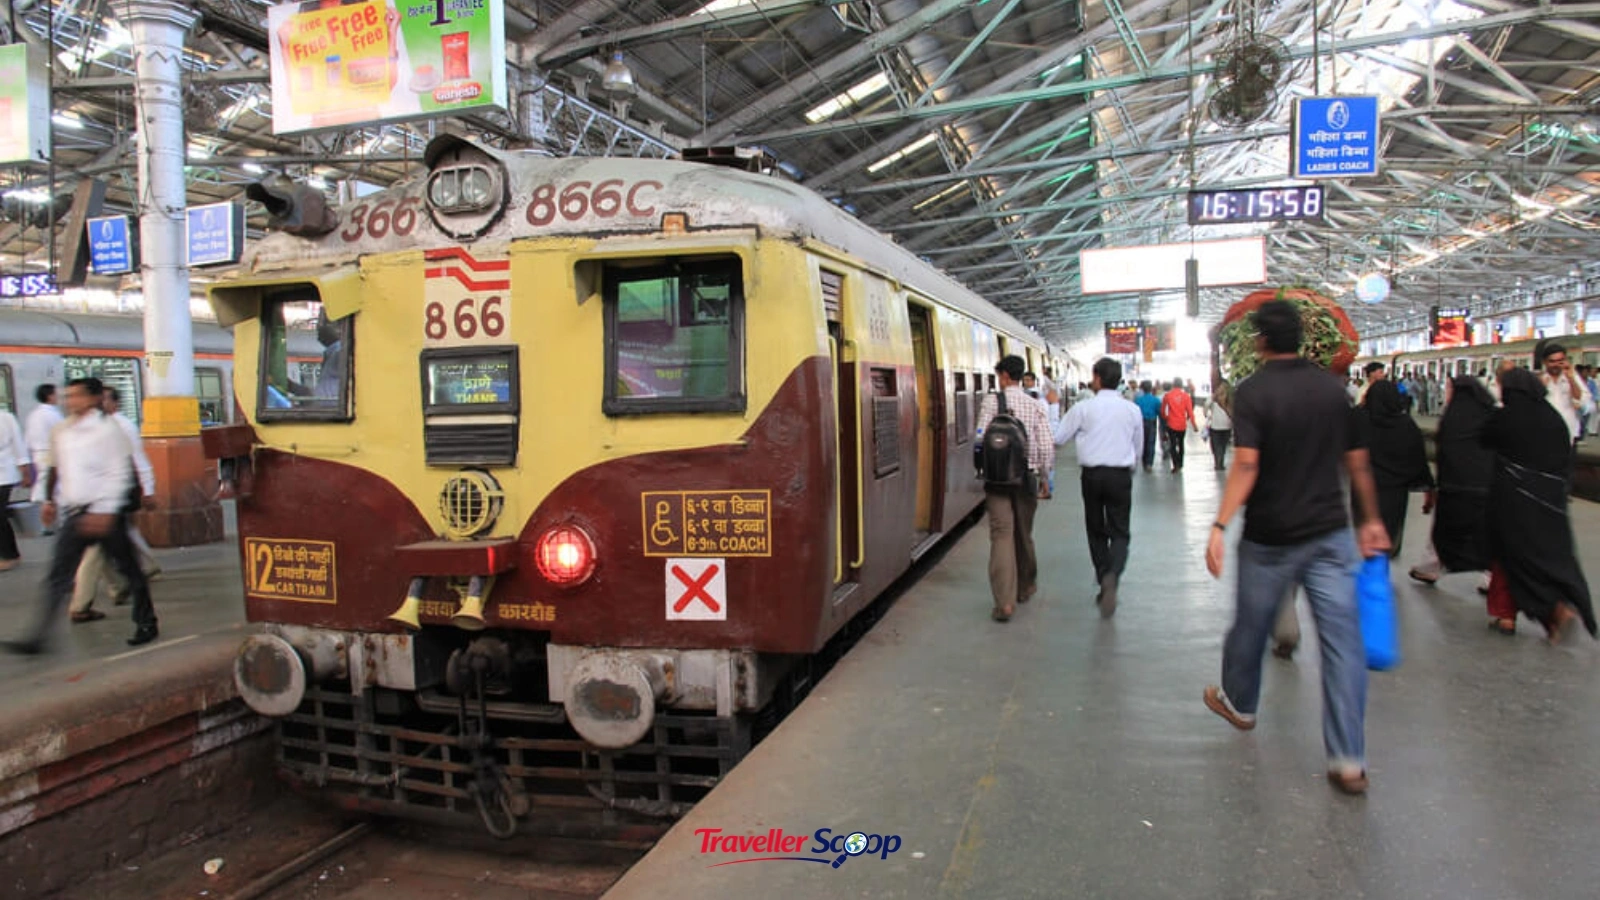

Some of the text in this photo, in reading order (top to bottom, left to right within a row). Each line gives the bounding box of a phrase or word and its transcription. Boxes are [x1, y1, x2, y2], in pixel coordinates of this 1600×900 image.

[326, 4, 379, 45] Free
[351, 27, 384, 52] Free
[1306, 161, 1370, 172] LADIES COACH
[525, 179, 664, 227] 866C
[1202, 188, 1321, 219] 16:15:58
[424, 296, 506, 339] 866
[719, 536, 767, 551] COACH
[249, 543, 276, 592] 12
[276, 581, 327, 596] CAR TRAIN
